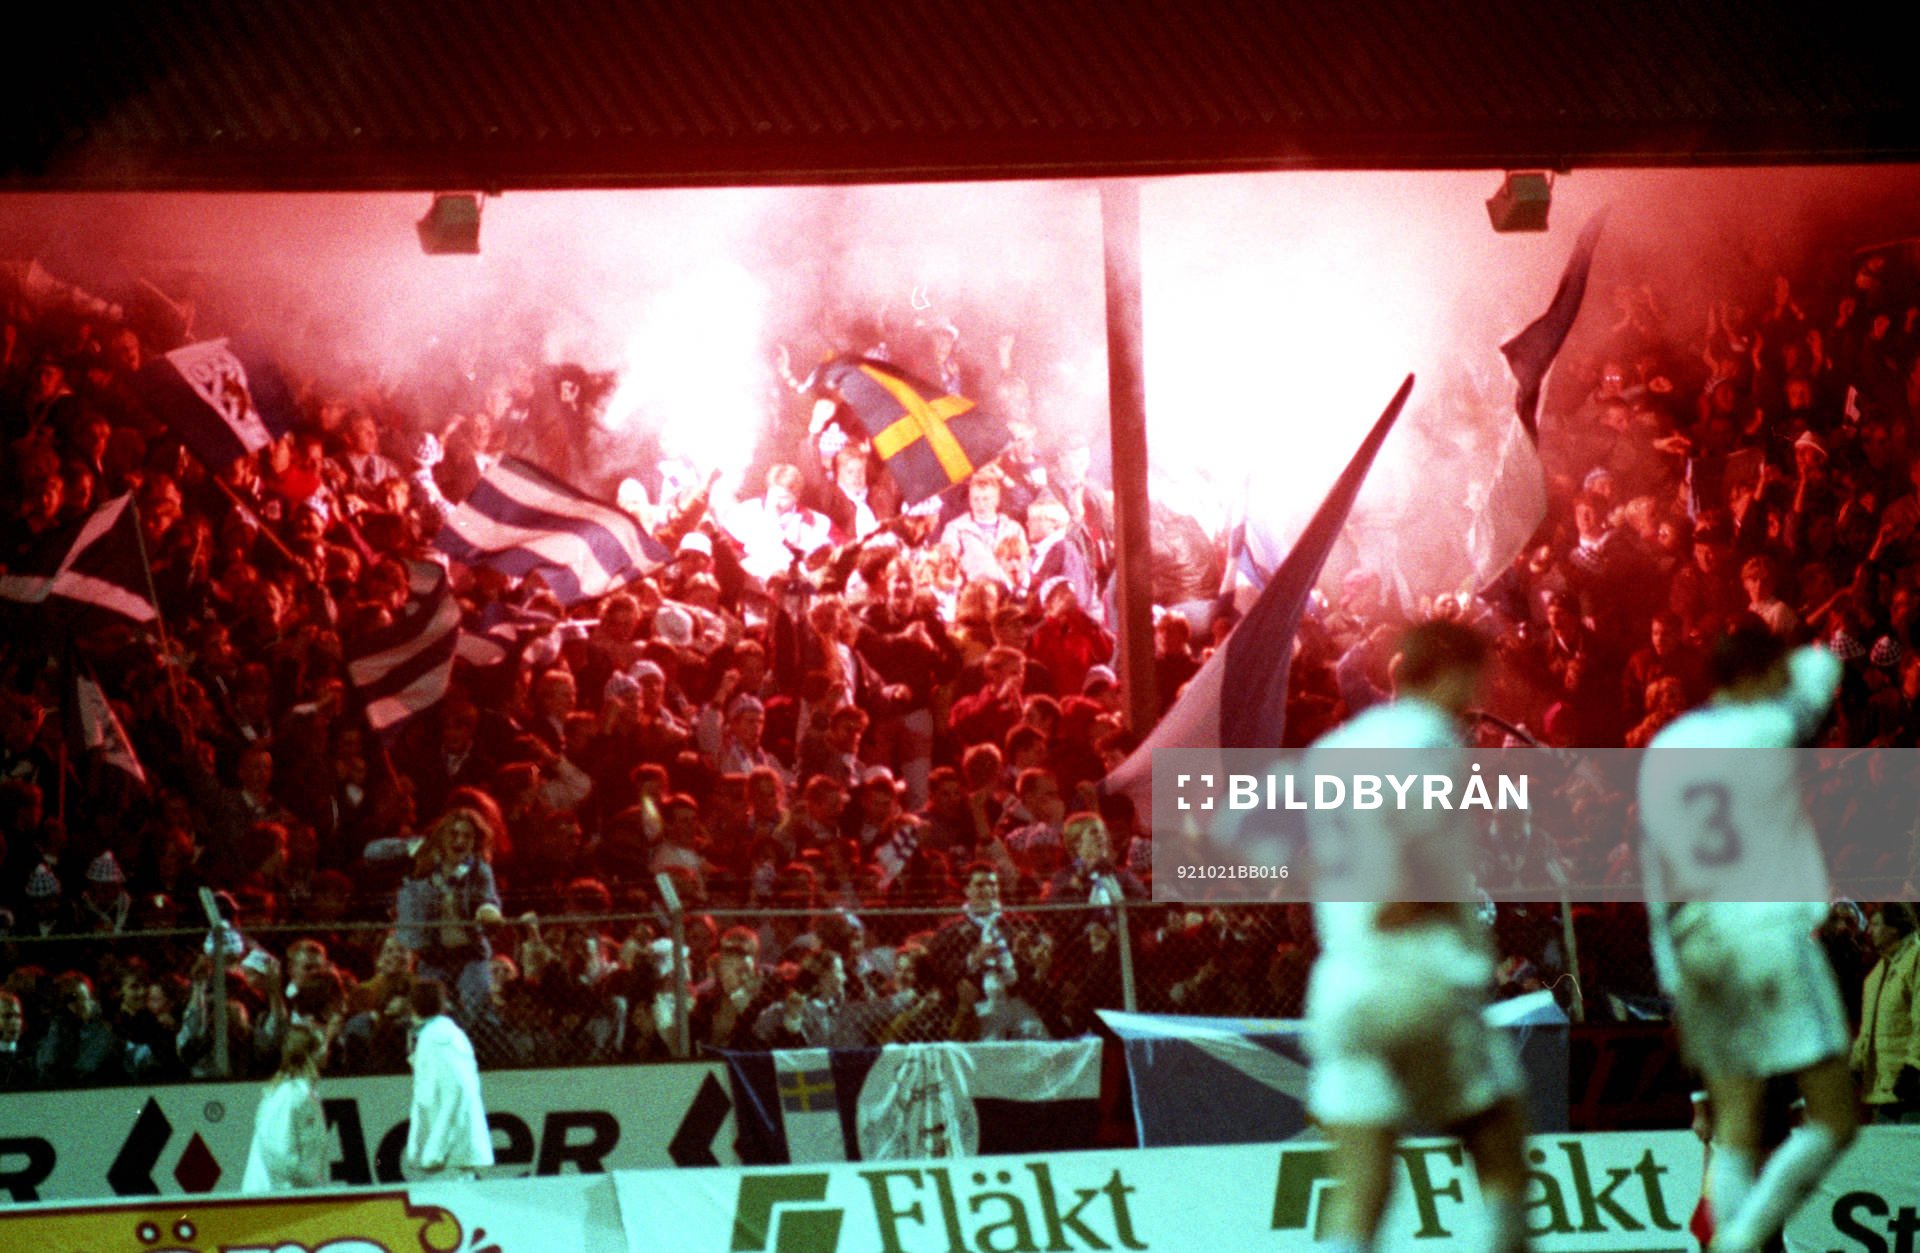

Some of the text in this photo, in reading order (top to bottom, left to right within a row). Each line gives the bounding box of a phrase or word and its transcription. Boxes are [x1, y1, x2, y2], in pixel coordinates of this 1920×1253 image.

[1682, 783, 1742, 865] 3
[857, 1162, 1149, 1253] Fläkt
[1398, 1141, 1682, 1239] Fäkt
